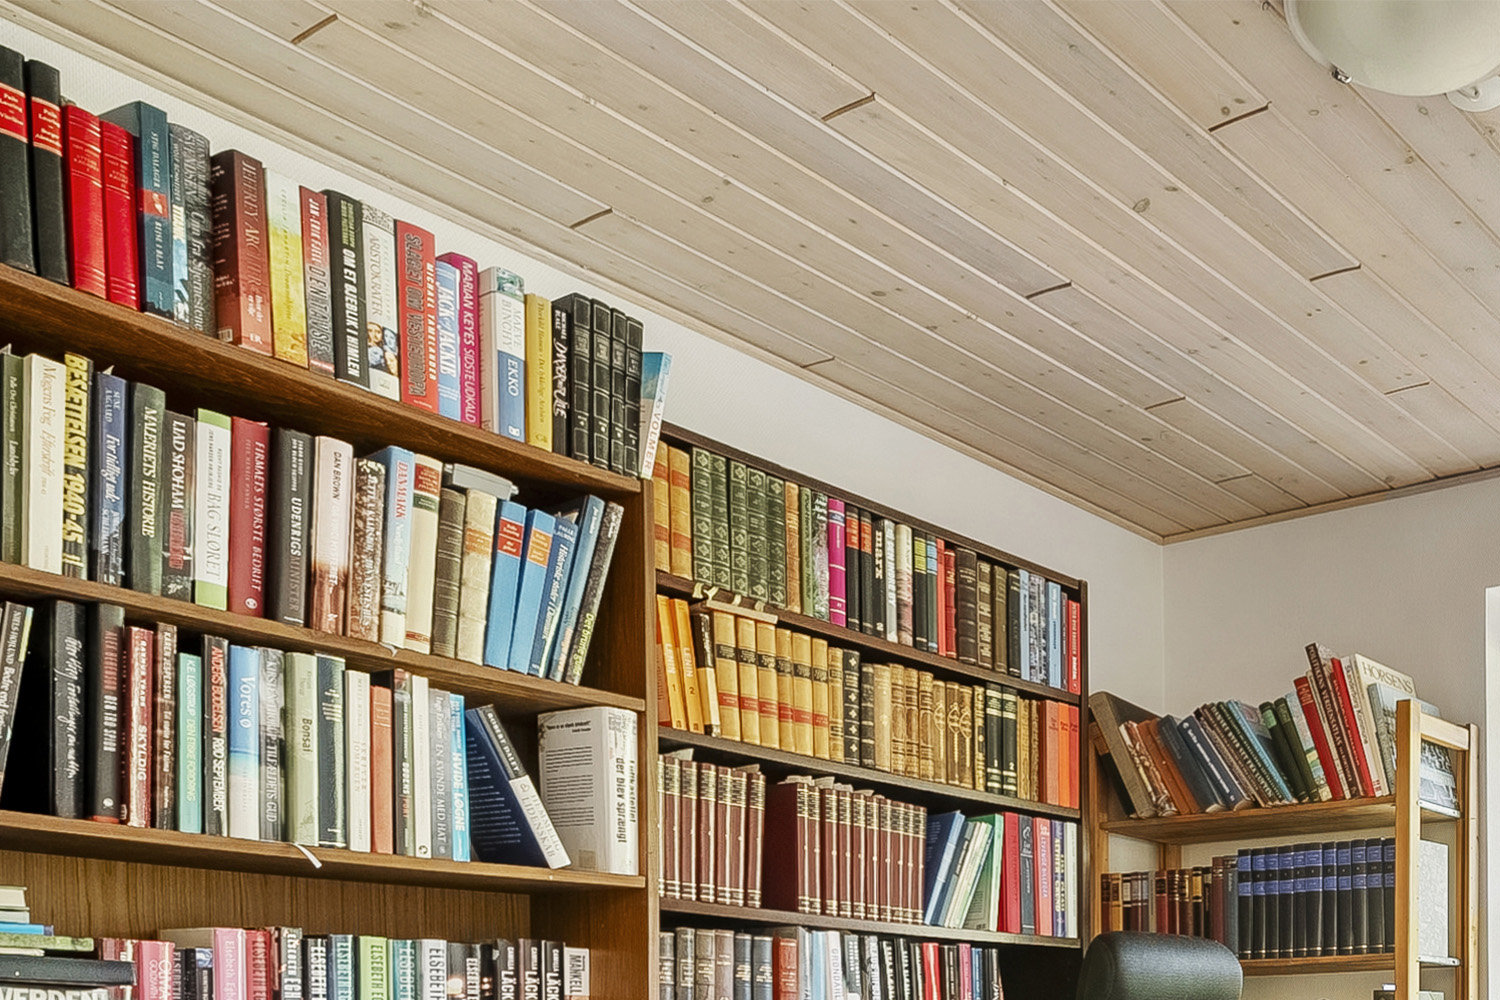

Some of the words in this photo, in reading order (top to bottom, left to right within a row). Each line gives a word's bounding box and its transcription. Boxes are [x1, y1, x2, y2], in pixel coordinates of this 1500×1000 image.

[343, 249, 354, 268] OM
[344, 270, 354, 283] ET
[463, 261, 473, 309] MARIAN
[464, 311, 475, 345] KEYES
[347, 336, 360, 377] HIMLEN
[42, 364, 56, 403] Mogens
[508, 358, 519, 396] EKKO
[41, 406, 54, 425] Fog
[65, 354, 88, 469] BESÆTTELSEN
[143, 407, 157, 477] MALERIETS
[173, 421, 185, 452] LIAD
[644, 412, 662, 470] VOLMER
[332, 452, 342, 467] DAN
[171, 454, 185, 509] SHOHAM
[332, 470, 342, 499] BROWN
[395, 461, 407, 518] DANMARK
[63, 474, 86, 542] 1940-45
[142, 480, 155, 537] HISTORIE
[875, 530, 883, 579] marx
[211, 646, 223, 684] ANDERS
[666, 643, 675, 674] LENIN
[683, 647, 694, 677] LENIN
[1363, 660, 1413, 694] HORSENS
[212, 685, 224, 733] BODELSEN
[240, 676, 255, 716] Vores
[136, 725, 147, 781] SKYLDIG
[213, 737, 224, 757] RØD
[301, 718, 312, 752] Bonsai
[213, 757, 224, 811] SEPTEMBER
[436, 759, 445, 795] KVINDE
[452, 753, 464, 790] HVIDE
[616, 758, 625, 774] der
[616, 778, 627, 797] blev
[436, 797, 445, 819] MED
[454, 793, 465, 831] LØGNE
[436, 822, 446, 842] HAT
[569, 954, 582, 995] MANKELL
